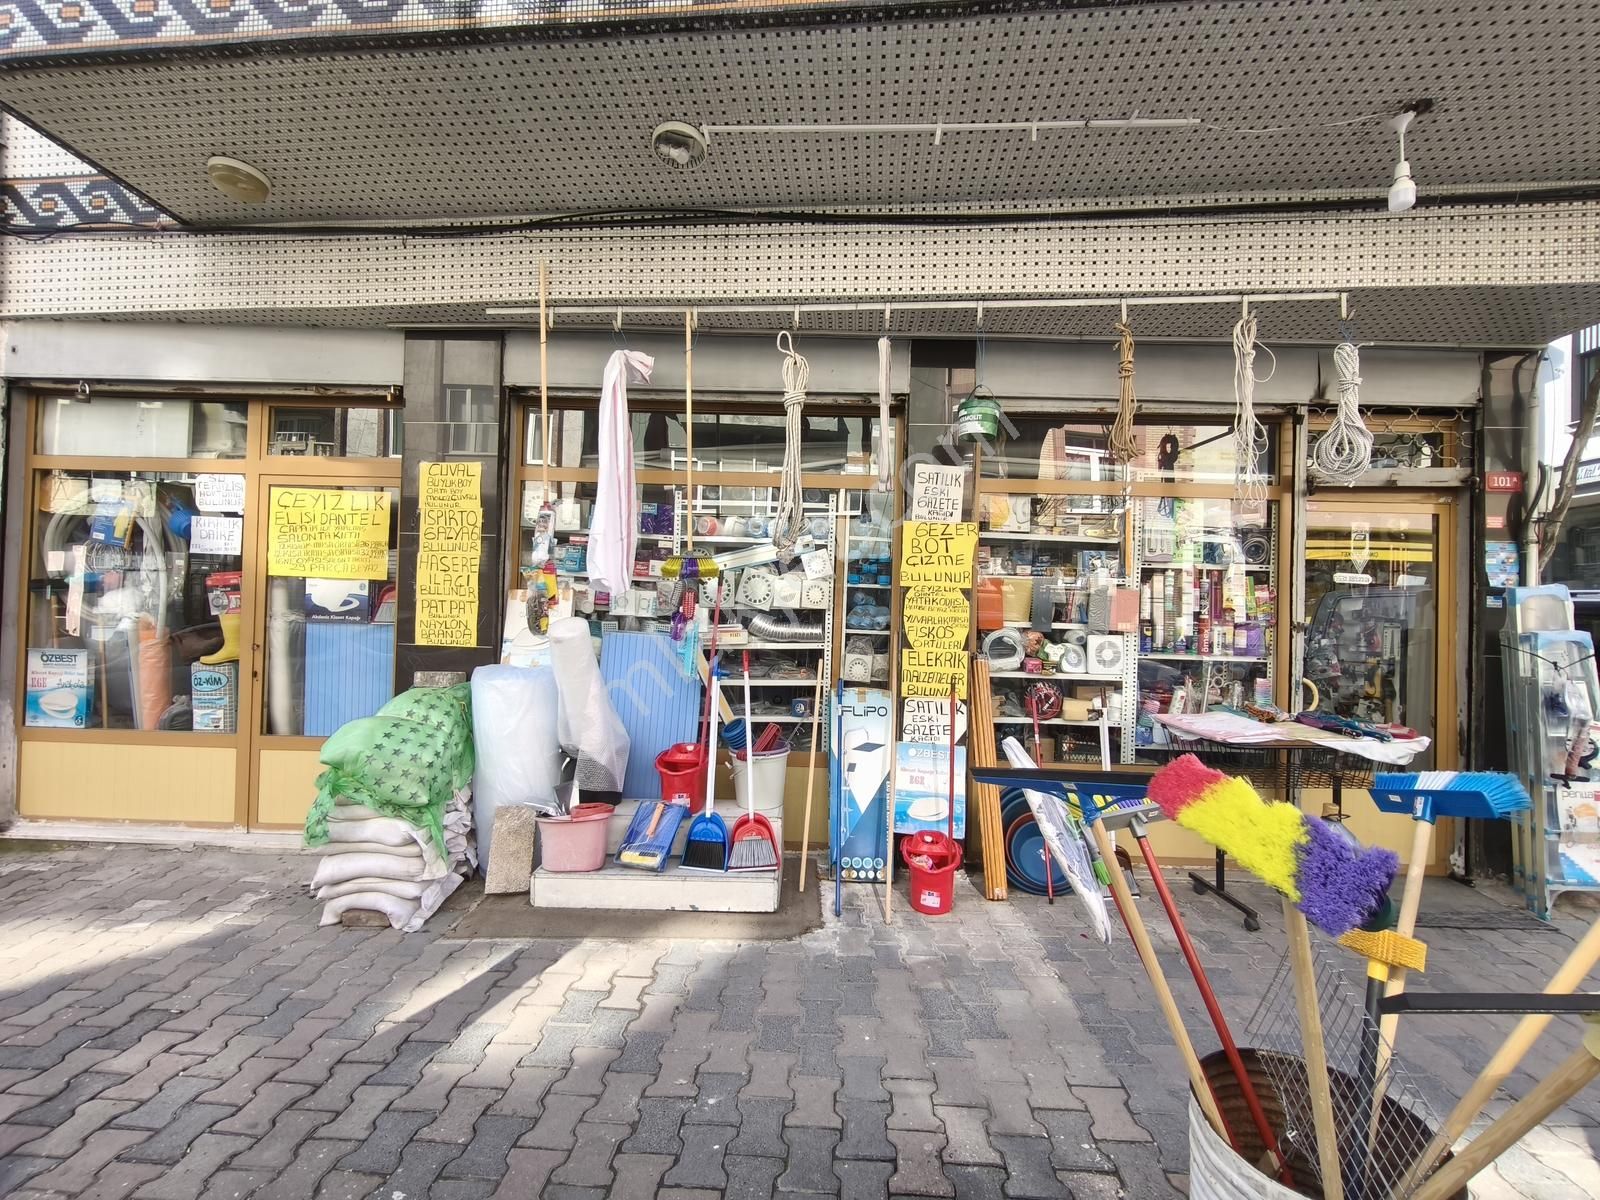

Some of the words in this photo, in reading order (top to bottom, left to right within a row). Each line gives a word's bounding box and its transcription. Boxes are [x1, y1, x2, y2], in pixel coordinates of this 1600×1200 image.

[917, 472, 962, 488] SATILIK
[1492, 476, 1510, 487] 101
[917, 496, 959, 510] GAZETE
[320, 512, 382, 526] DANTEL
[916, 522, 978, 537] GEZER
[278, 533, 316, 544] SALON
[422, 542, 478, 552] BULUNUR
[912, 537, 954, 554] BOT
[900, 571, 970, 584] BULUNUR
[420, 584, 476, 598] BULUNUR
[420, 619, 468, 630] NAYLON
[421, 628, 472, 640] BRANDA
[40, 651, 78, 663] ÖZBEST
[906, 700, 964, 715] SATILK
[902, 724, 952, 736] GAZETE
